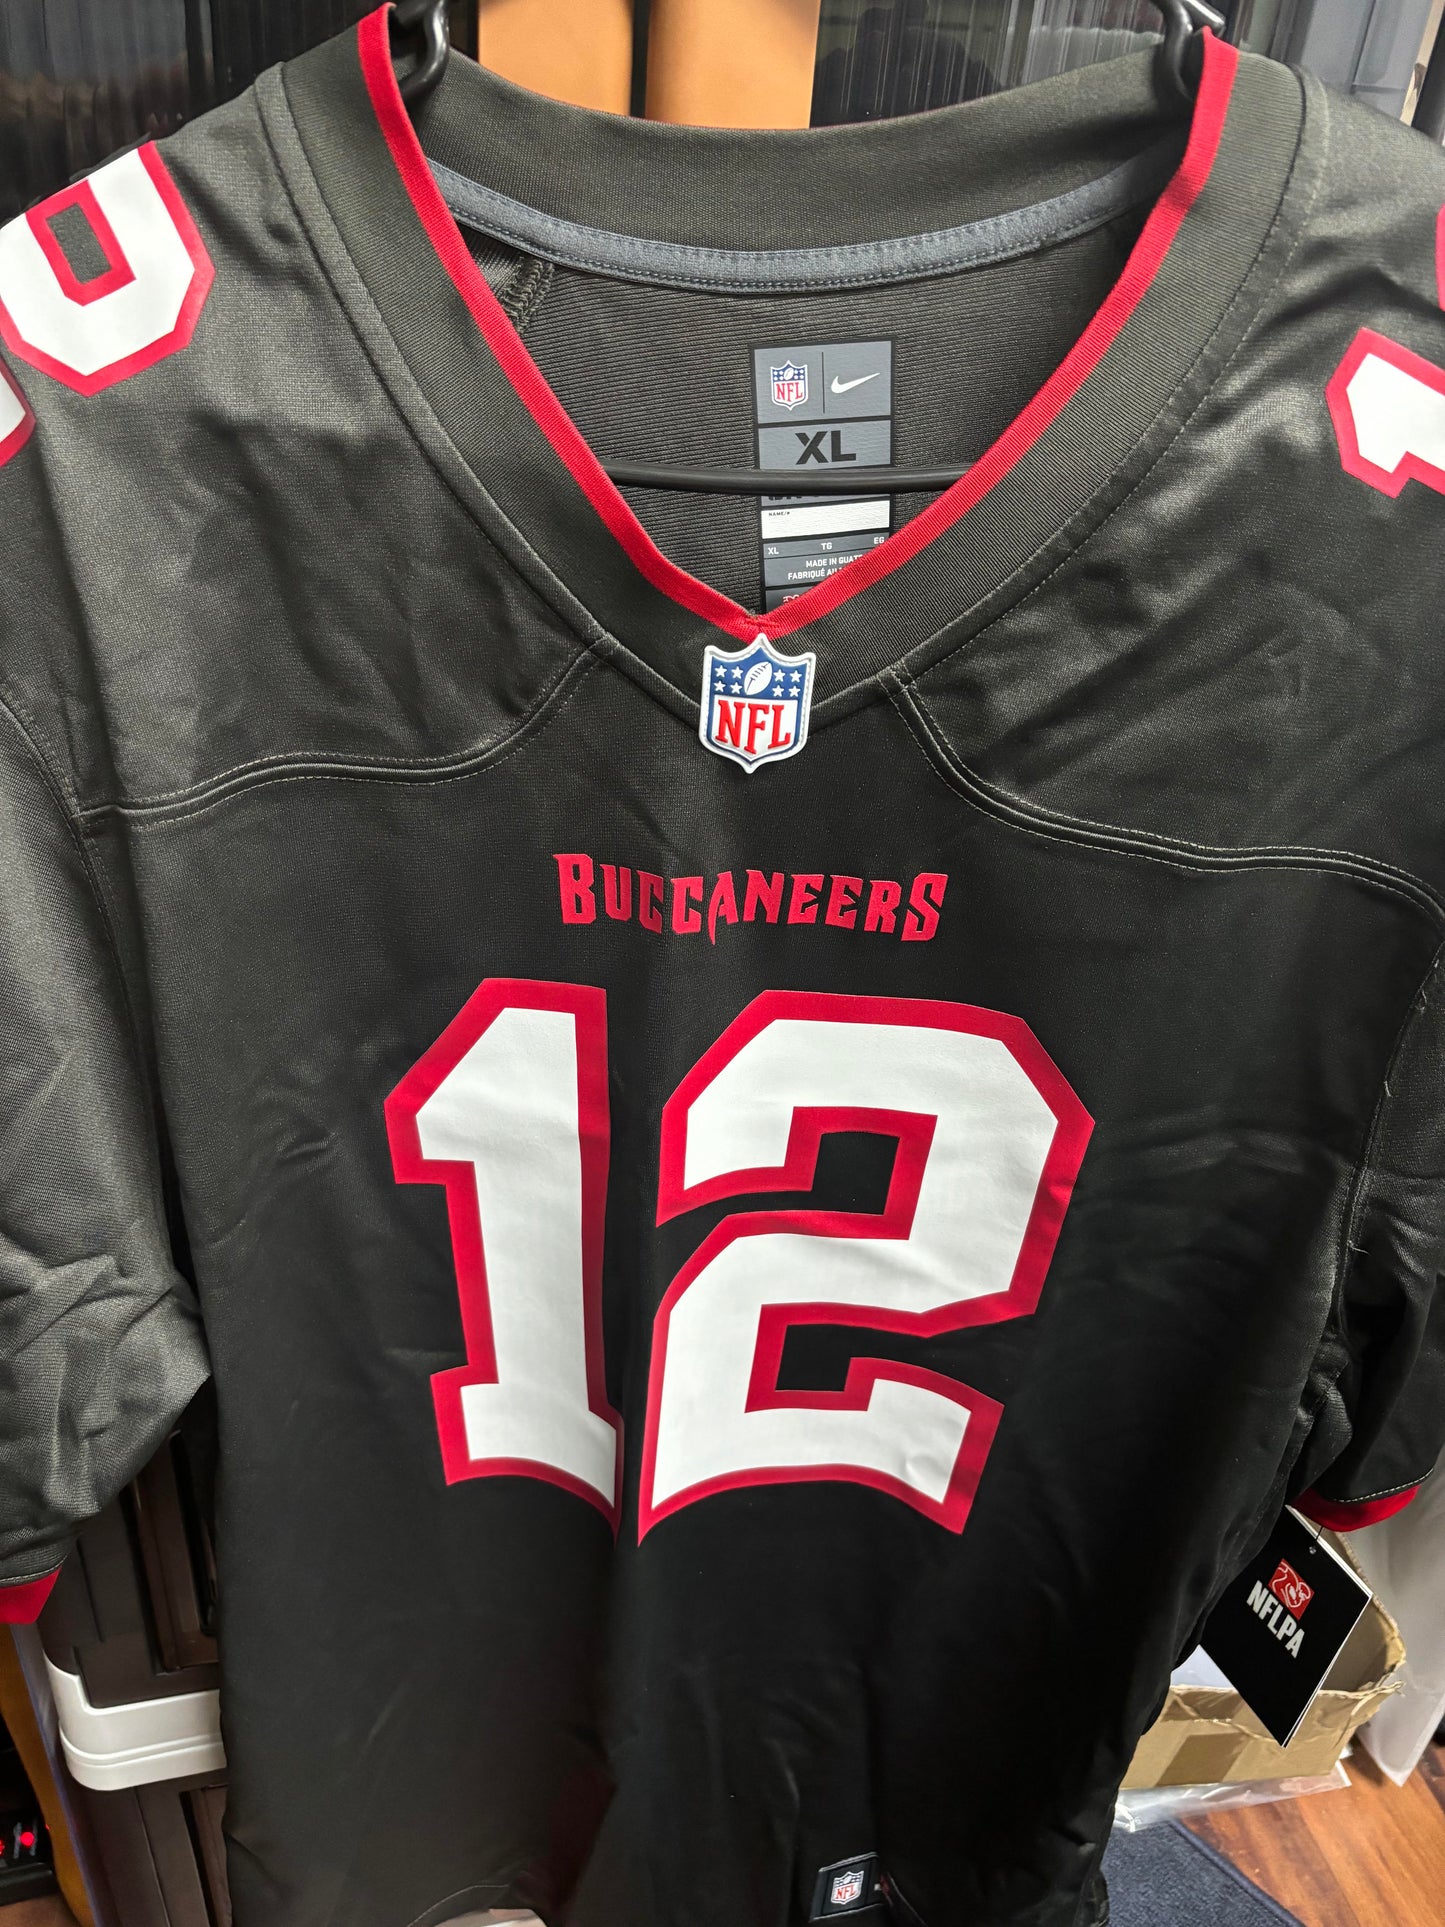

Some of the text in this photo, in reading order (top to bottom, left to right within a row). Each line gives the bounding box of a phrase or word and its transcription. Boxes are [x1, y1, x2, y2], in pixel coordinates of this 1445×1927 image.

[776, 382, 803, 403] NFL
[795, 430, 857, 465] XL
[768, 536, 885, 555] XL TG EG
[788, 569, 825, 581] FABRIQUÉ
[806, 554, 864, 568] MADE IN GUAT
[714, 699, 791, 755] NFL
[552, 852, 948, 945] BUCCANEERS
[384, 977, 1095, 1547] 12
[1246, 1580, 1306, 1659] NFLPA
[836, 1884, 856, 1900] NFL
